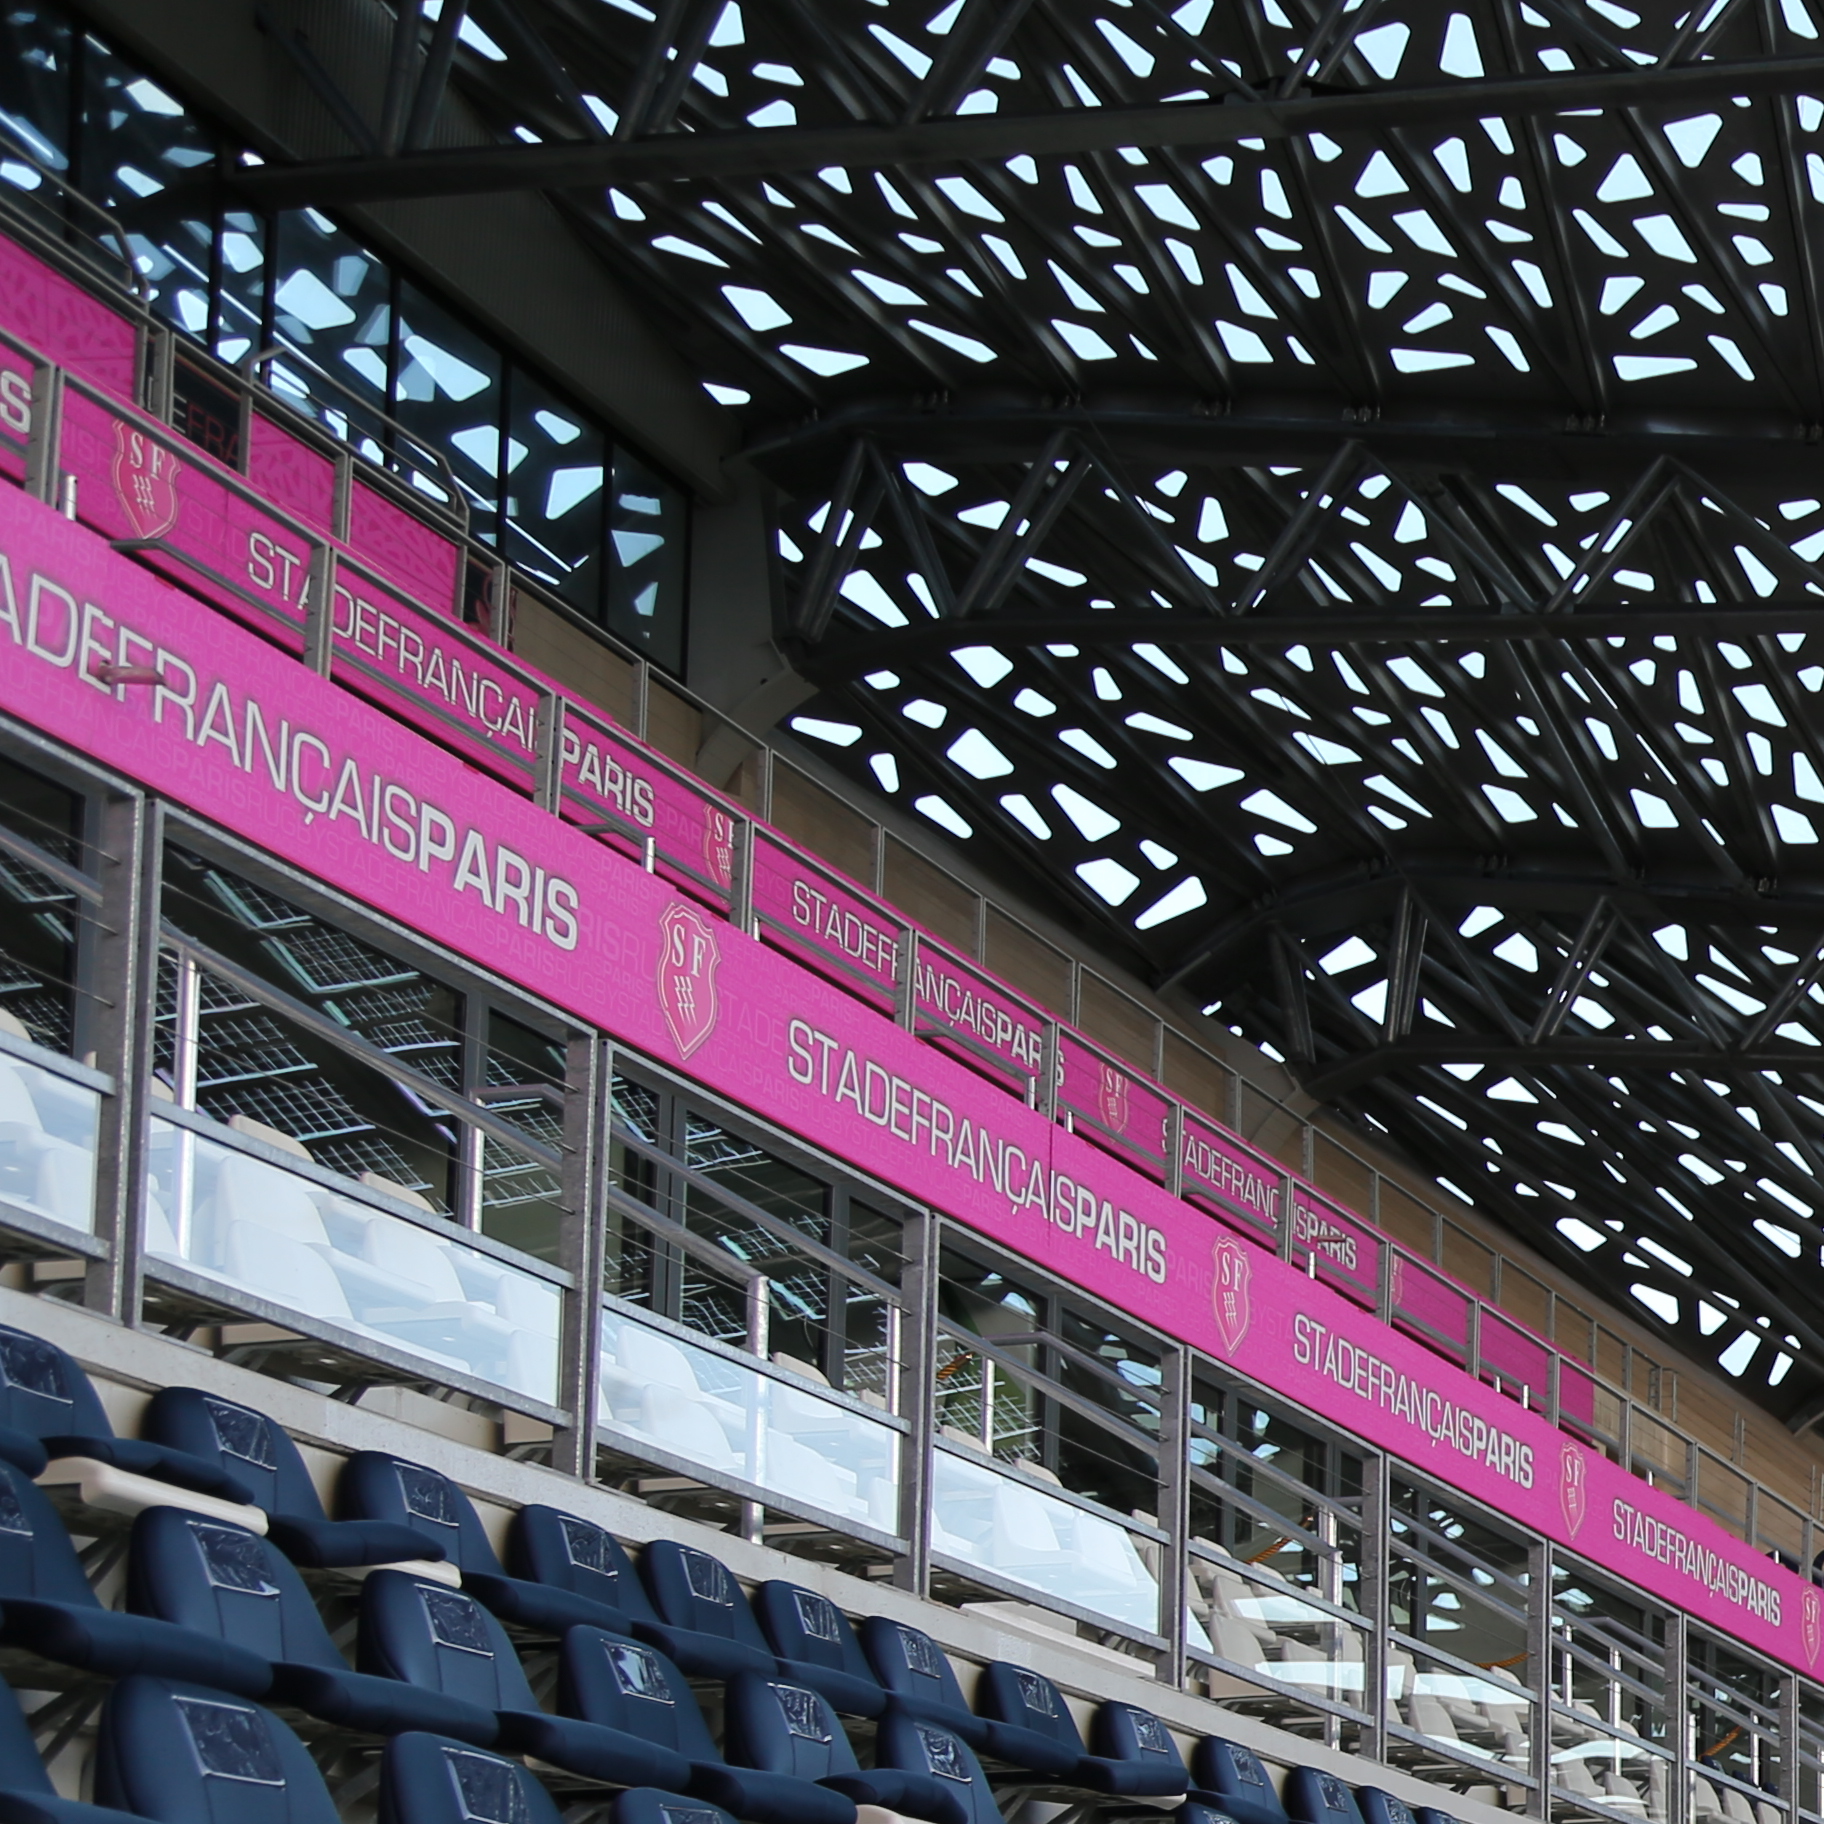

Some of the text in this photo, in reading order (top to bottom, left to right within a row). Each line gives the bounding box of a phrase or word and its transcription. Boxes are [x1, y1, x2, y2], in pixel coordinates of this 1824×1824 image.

[248, 531, 656, 828] STDEFRANÇAIPARIS
[788, 1019, 1167, 1285] STADEFRANÇAISPARIS
[1293, 1314, 1535, 1490] STADEFRANÇAISPARIS
[1613, 1499, 1782, 1628] STADEFRANÇAISPARIS
